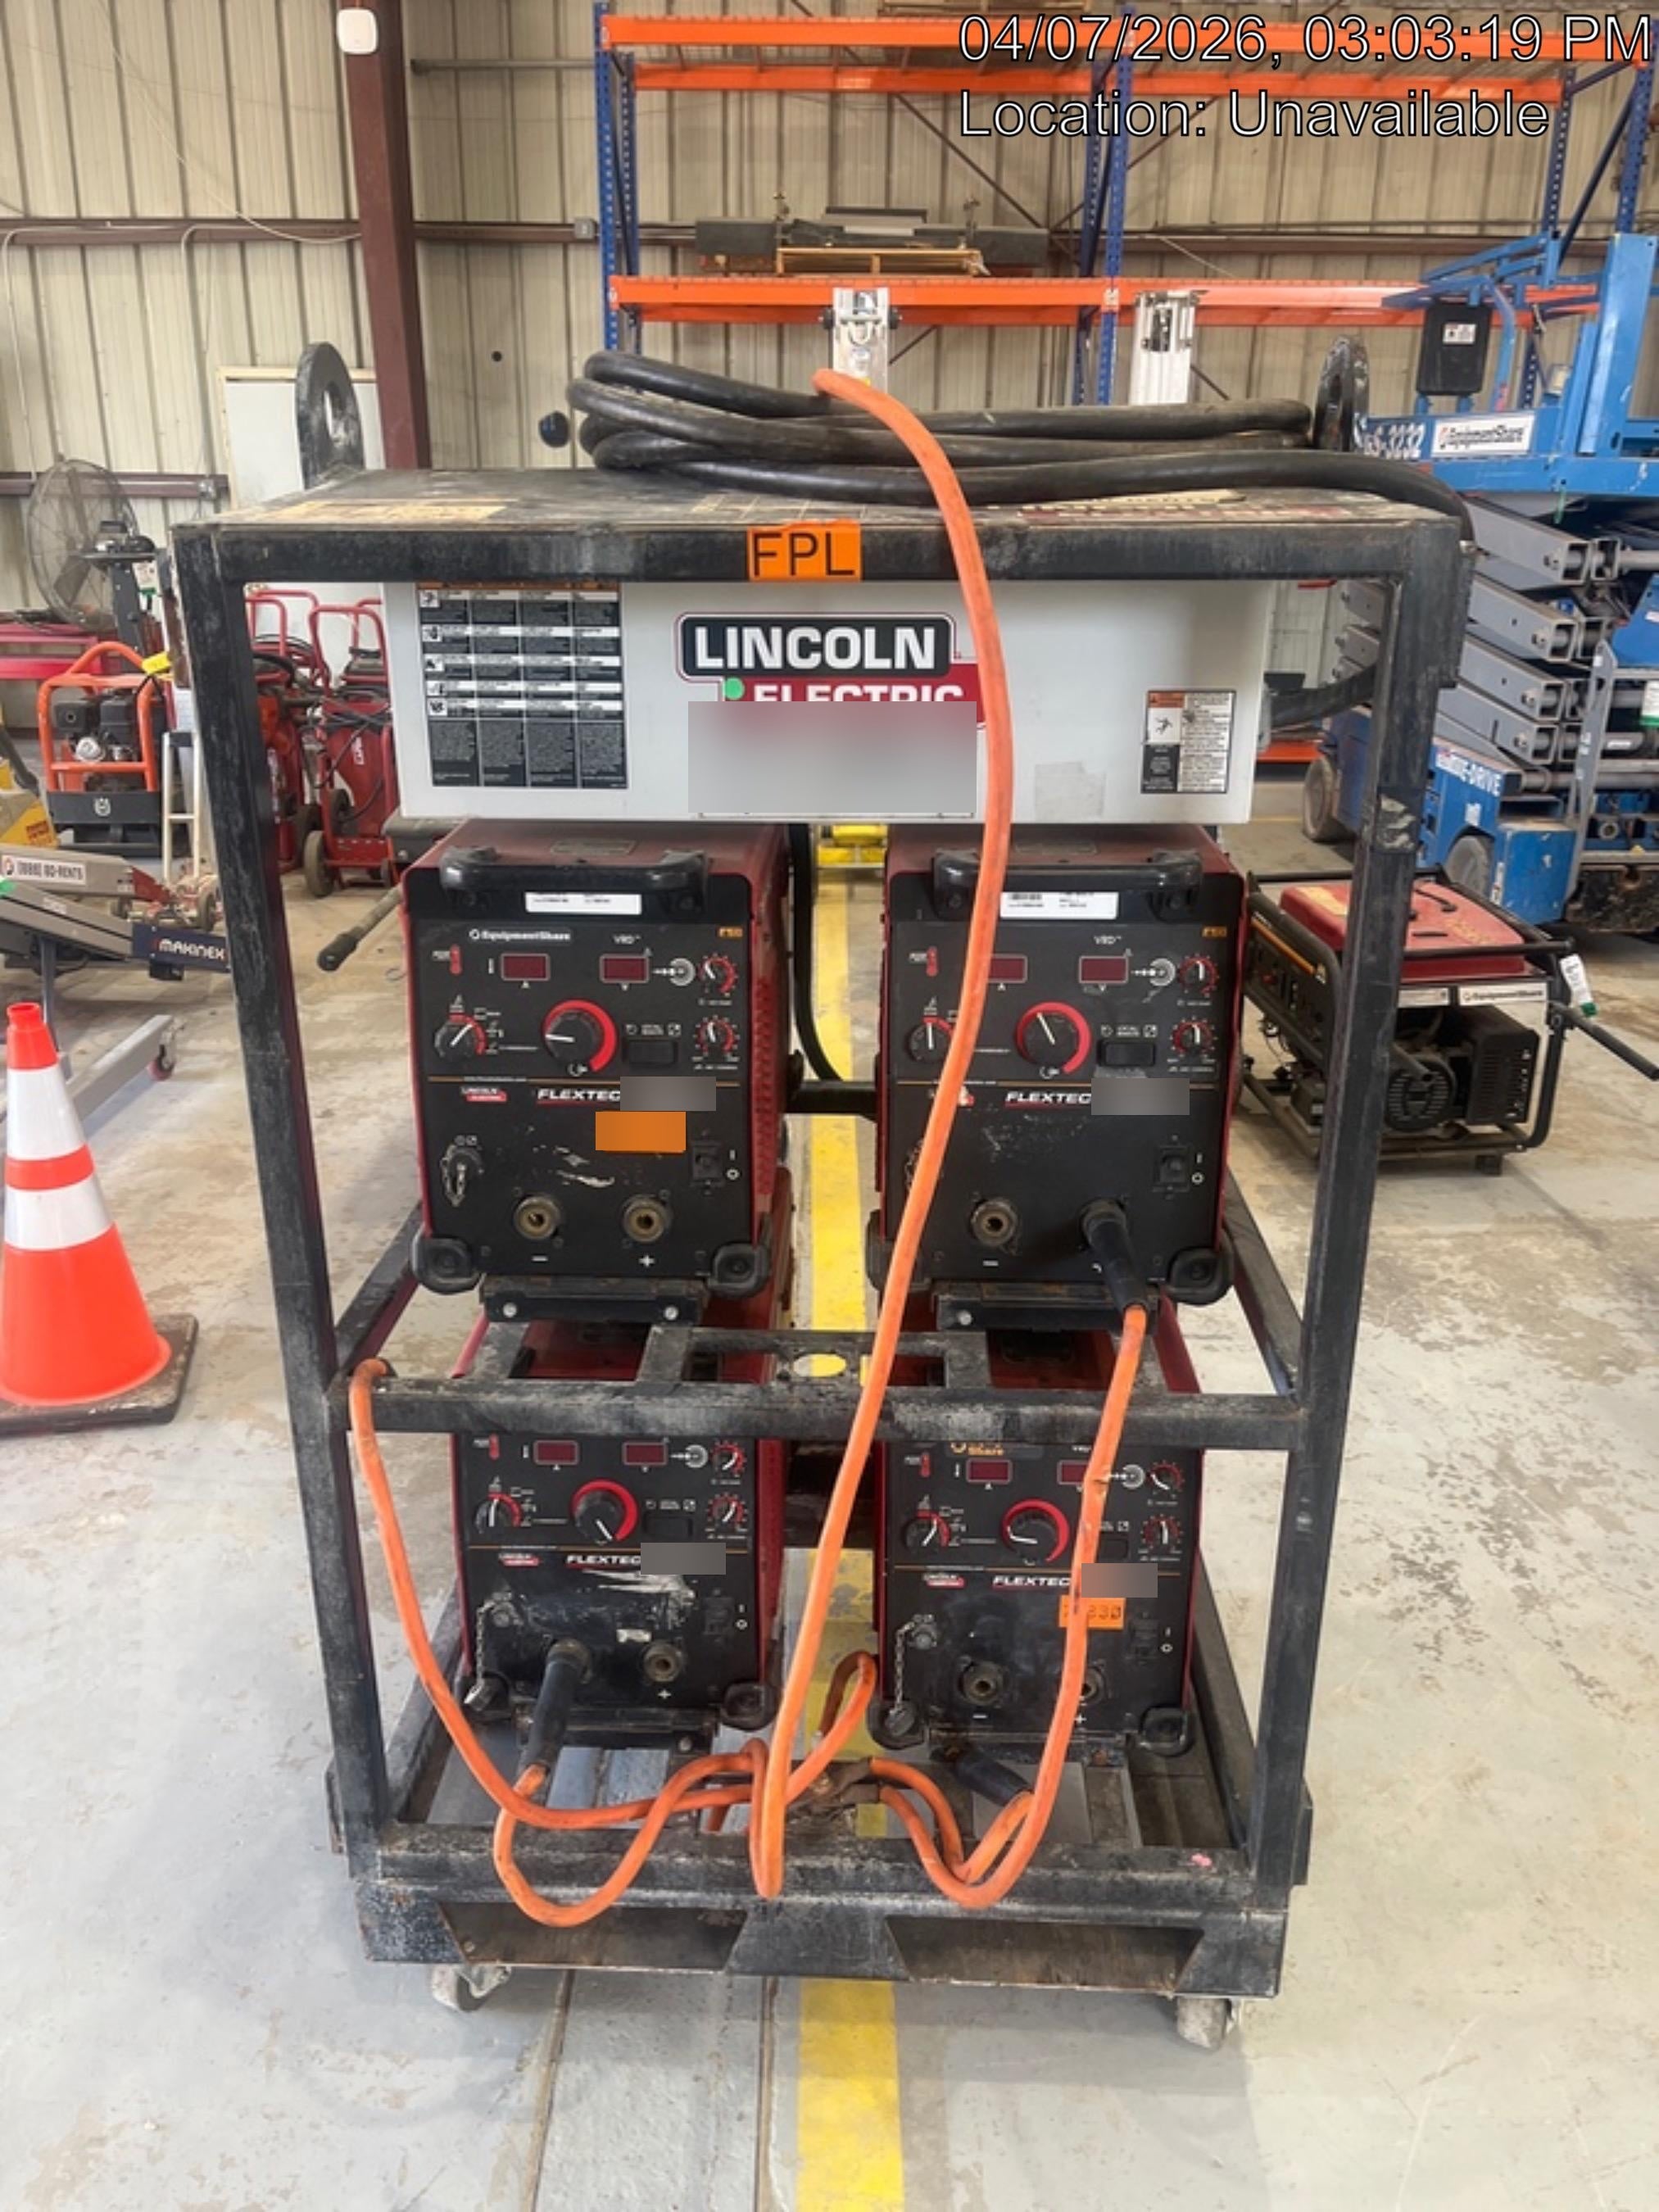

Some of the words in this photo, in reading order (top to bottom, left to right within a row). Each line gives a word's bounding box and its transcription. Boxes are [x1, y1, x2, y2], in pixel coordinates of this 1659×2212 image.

[752, 533, 855, 576] FPL
[695, 626, 936, 670] LINCOLN
[481, 930, 571, 941] EquipmentShare
